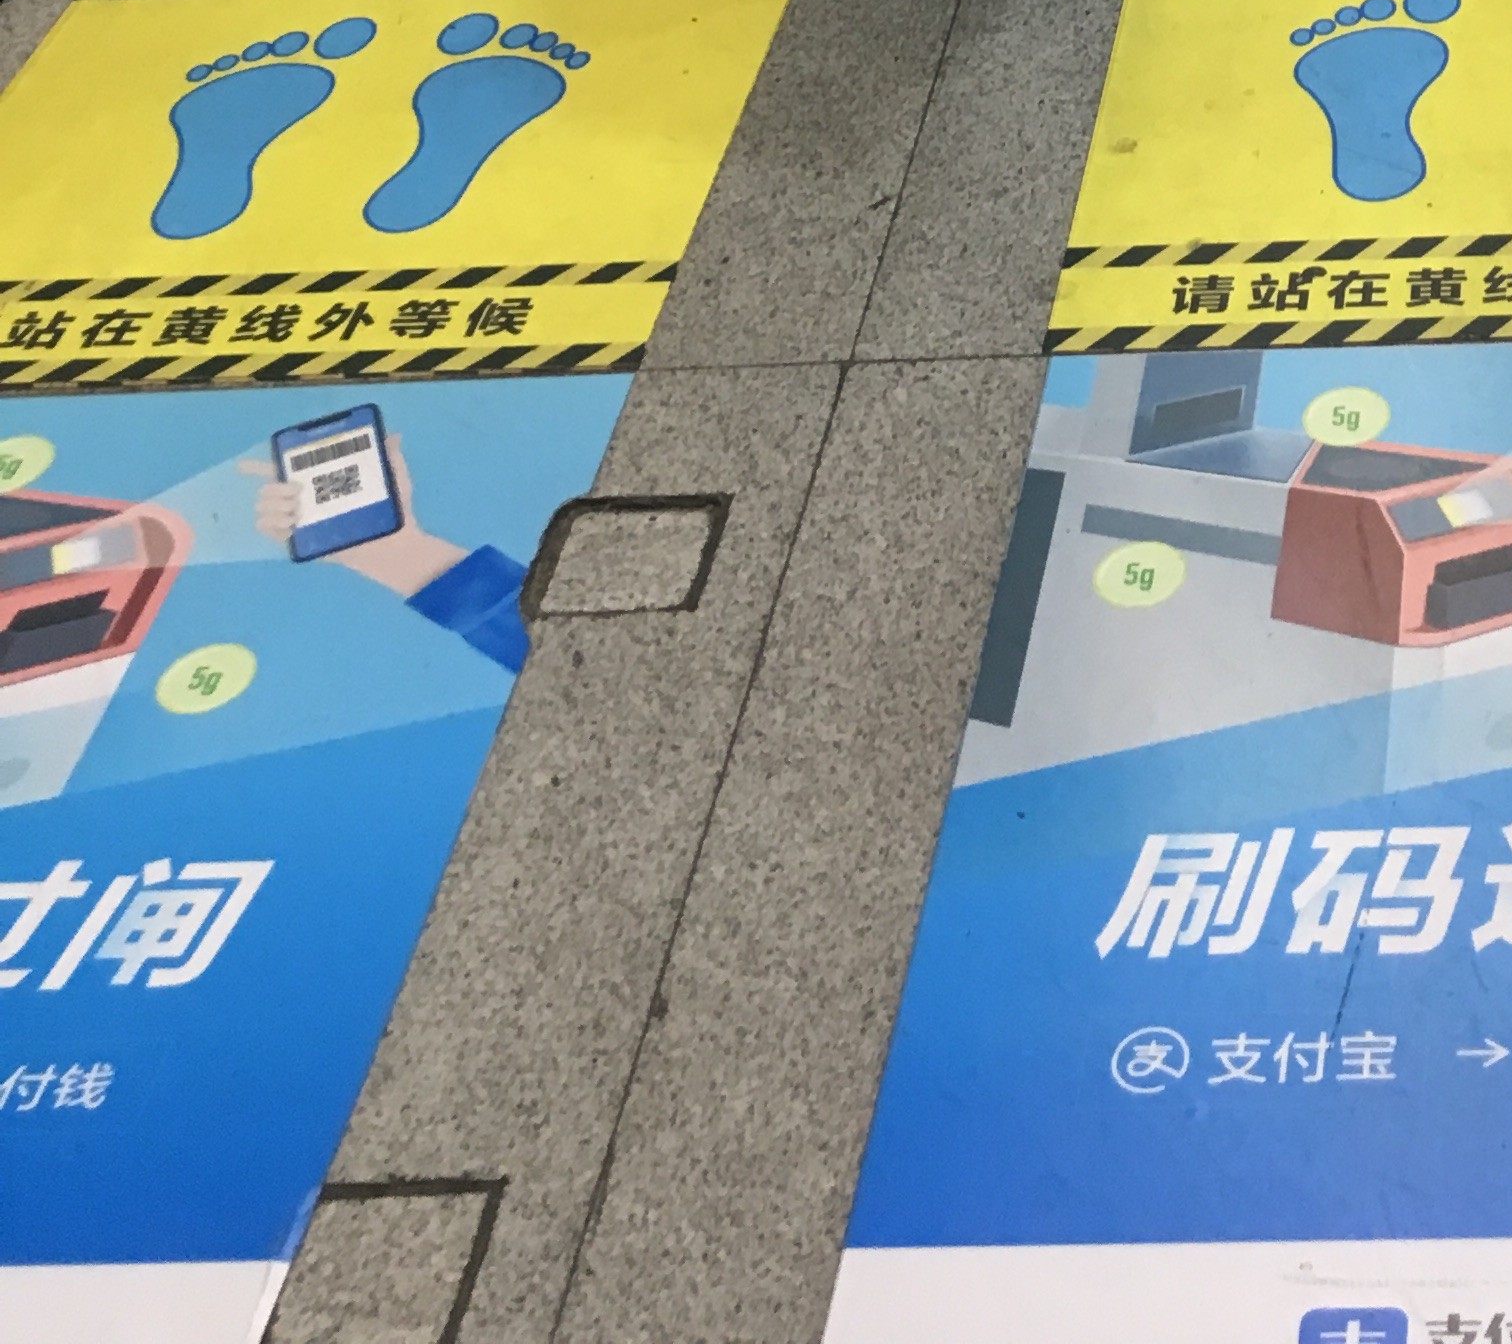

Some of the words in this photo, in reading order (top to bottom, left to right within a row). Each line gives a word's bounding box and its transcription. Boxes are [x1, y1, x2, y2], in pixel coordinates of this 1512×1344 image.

[1330, 403, 1361, 432] 5g
[1124, 561, 1156, 591] 5g
[188, 666, 222, 696] 5g
[1209, 1028, 1399, 1085] 支付宝
[0, 1062, 115, 1111] 付钱
